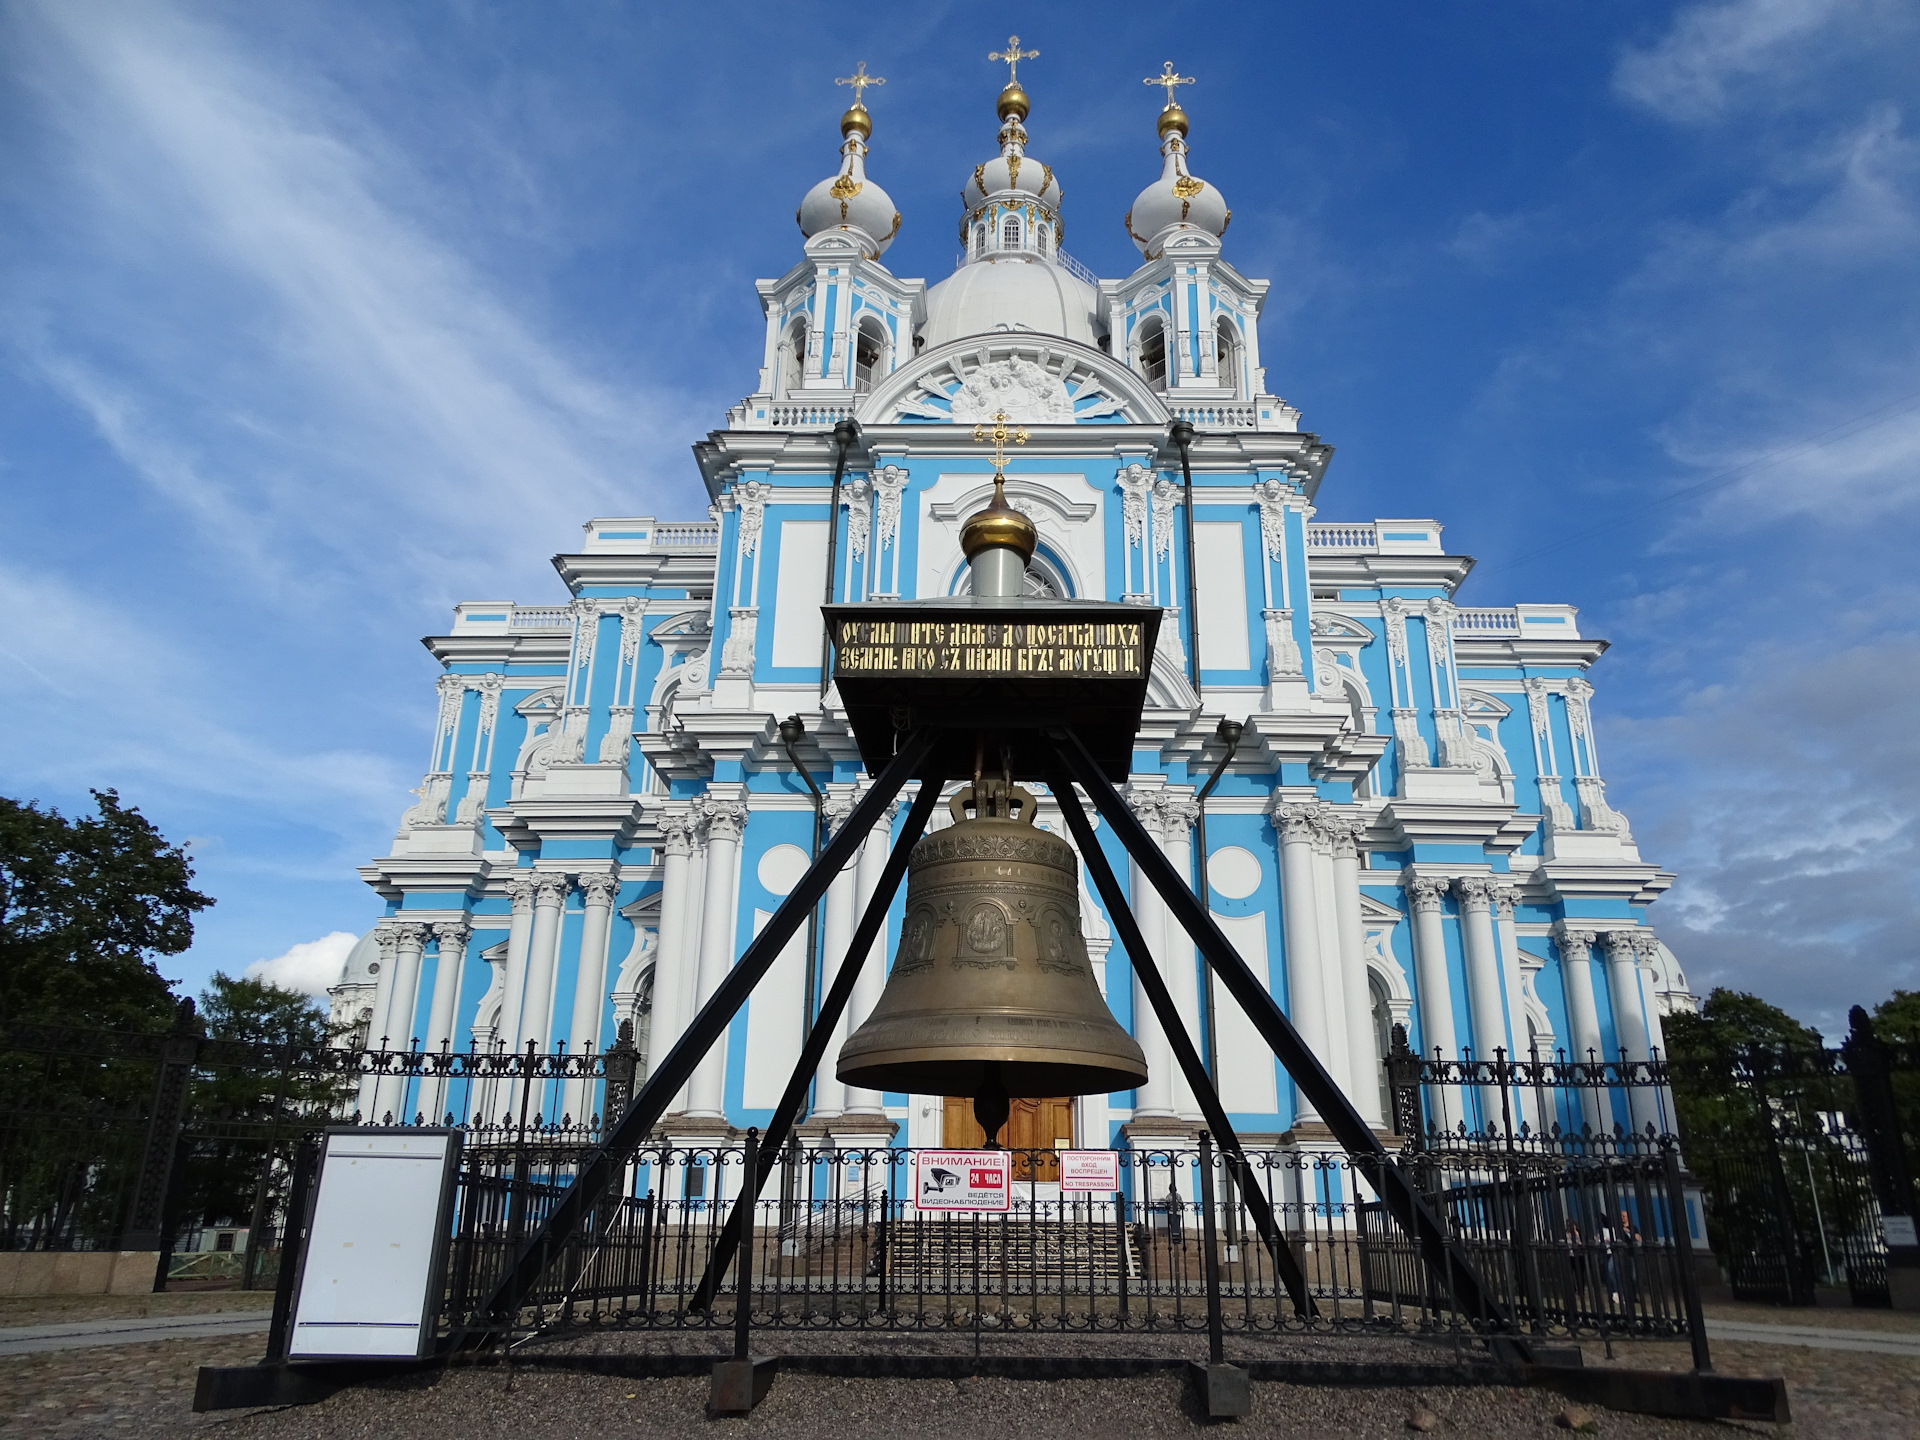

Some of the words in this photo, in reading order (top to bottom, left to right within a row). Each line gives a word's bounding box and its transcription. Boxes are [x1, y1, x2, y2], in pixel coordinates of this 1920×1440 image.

[949, 622, 997, 648] ДАЖЕ
[922, 1158, 1004, 1166] ВНИМАНИЕ!
[970, 1173, 980, 1184] 24
[984, 1173, 1002, 1184] ЧАСА
